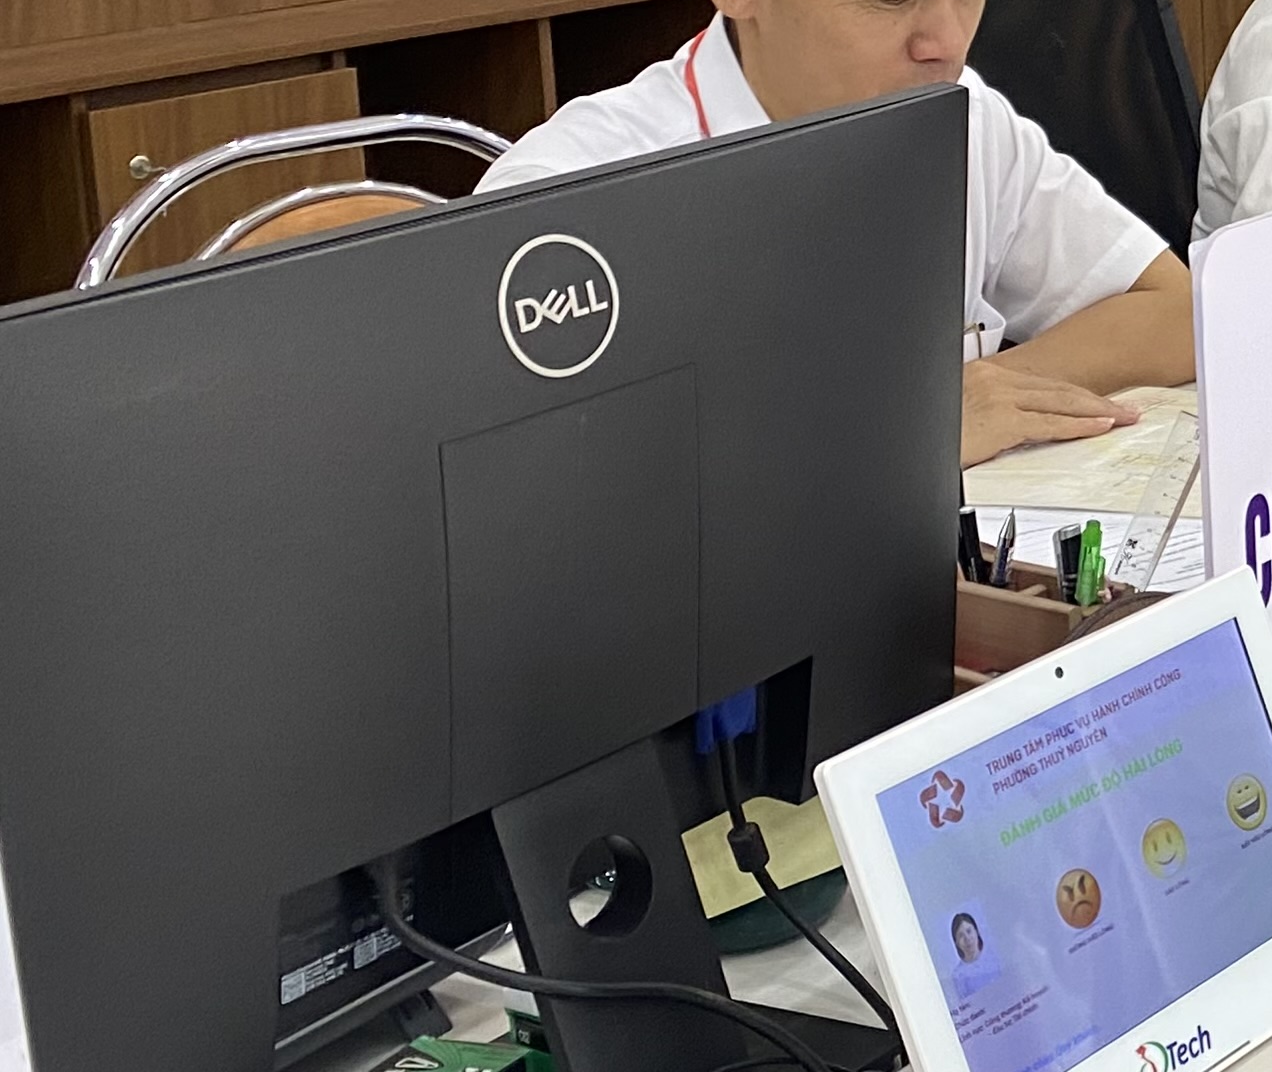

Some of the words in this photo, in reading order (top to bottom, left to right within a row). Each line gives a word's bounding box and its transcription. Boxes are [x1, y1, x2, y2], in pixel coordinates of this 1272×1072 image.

[514, 279, 608, 333] DELL
[985, 748, 1022, 776] TRUNG
[1022, 735, 1044, 756] TÂM
[1045, 722, 1075, 745] PHỤC
[1075, 714, 1090, 729] VỤ
[1092, 699, 1121, 721] HÀNH
[1120, 682, 1153, 707] CHÍNH
[1154, 668, 1181, 690] CÔNG
[992, 762, 1038, 795] PHƯỜNG
[1066, 727, 1108, 756] NGUYÊN
[1001, 815, 1042, 848] ĐÁNH
[1042, 798, 1068, 824] GIÁ
[1069, 783, 1100, 810] MỨC
[1102, 769, 1122, 794] ĐỘ
[1122, 755, 1148, 780] HÀI
[1149, 739, 1183, 768] LÒNG
[1166, 1025, 1211, 1070] Tech
